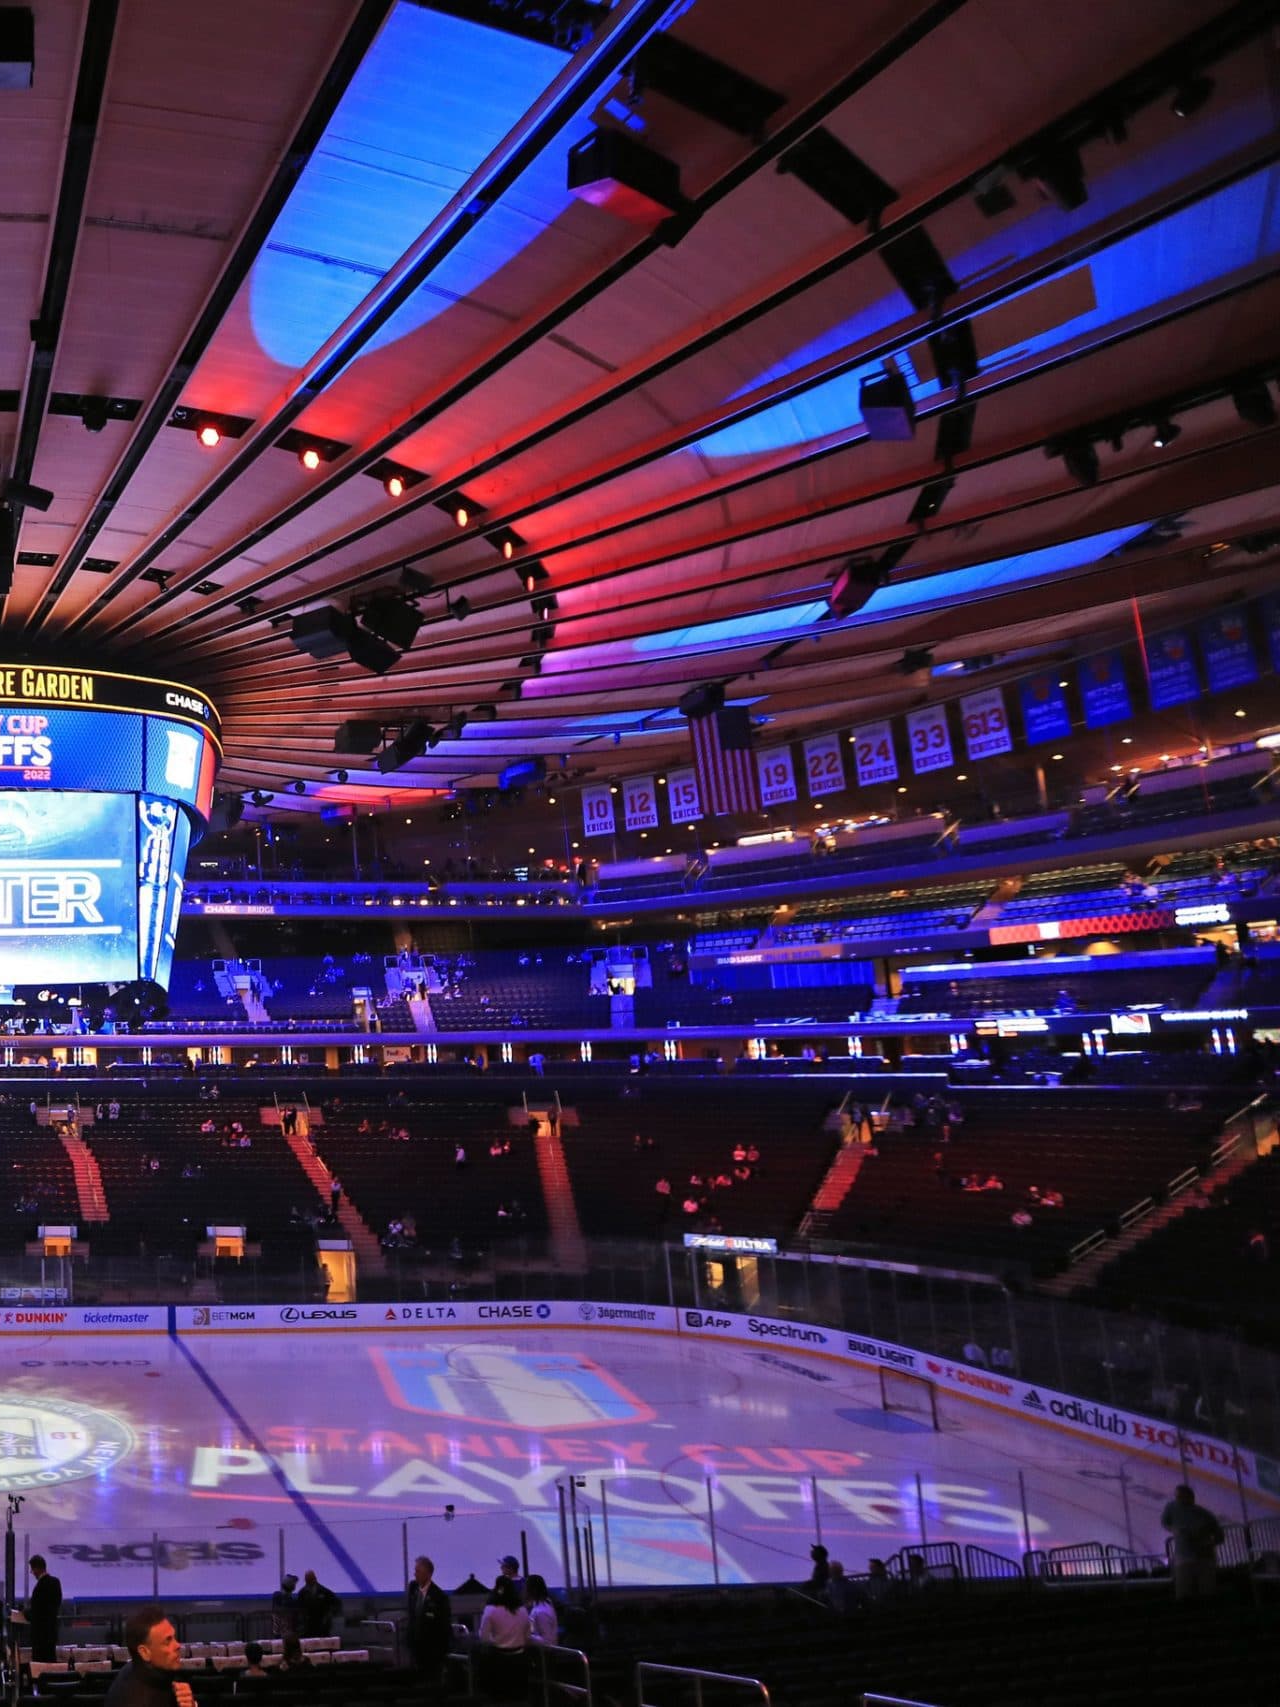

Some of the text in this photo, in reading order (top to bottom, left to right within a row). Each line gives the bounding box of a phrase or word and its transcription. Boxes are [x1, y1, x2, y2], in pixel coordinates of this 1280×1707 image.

[23, 669, 93, 700] GARDEN
[166, 693, 204, 715] CHASE
[7, 715, 48, 735] CUP
[966, 708, 1006, 738] 613
[913, 724, 945, 753] 33
[857, 739, 890, 767] 24
[809, 751, 839, 777] 22
[23, 770, 51, 780] 2022
[764, 764, 787, 787] 19
[629, 792, 651, 813] 12
[673, 784, 696, 806] 15
[587, 800, 608, 820] 10
[627, 814, 656, 827] KNICKS
[586, 821, 613, 833] KNICKS
[205, 905, 237, 913] CHASE
[737, 954, 762, 964] LIGHT
[735, 1240, 771, 1251] ULTRA
[15, 1313, 68, 1323] DUNKIN'
[83, 1312, 150, 1323] ticketmaster
[212, 1311, 256, 1321] BETMGM
[301, 1310, 358, 1320] LEXUS
[403, 1308, 456, 1319] DELTA
[478, 1305, 533, 1319] CHASE
[748, 1319, 823, 1343] Spectrum
[848, 1339, 916, 1367] BUD LIGHT
[1050, 1400, 1128, 1436] adiclub
[80, 1440, 121, 1467] NEW
[264, 1426, 864, 1476] STANLEY CUP
[1132, 1422, 1252, 1475] HONDA
[192, 1447, 1050, 1534] PLAYOFFS
